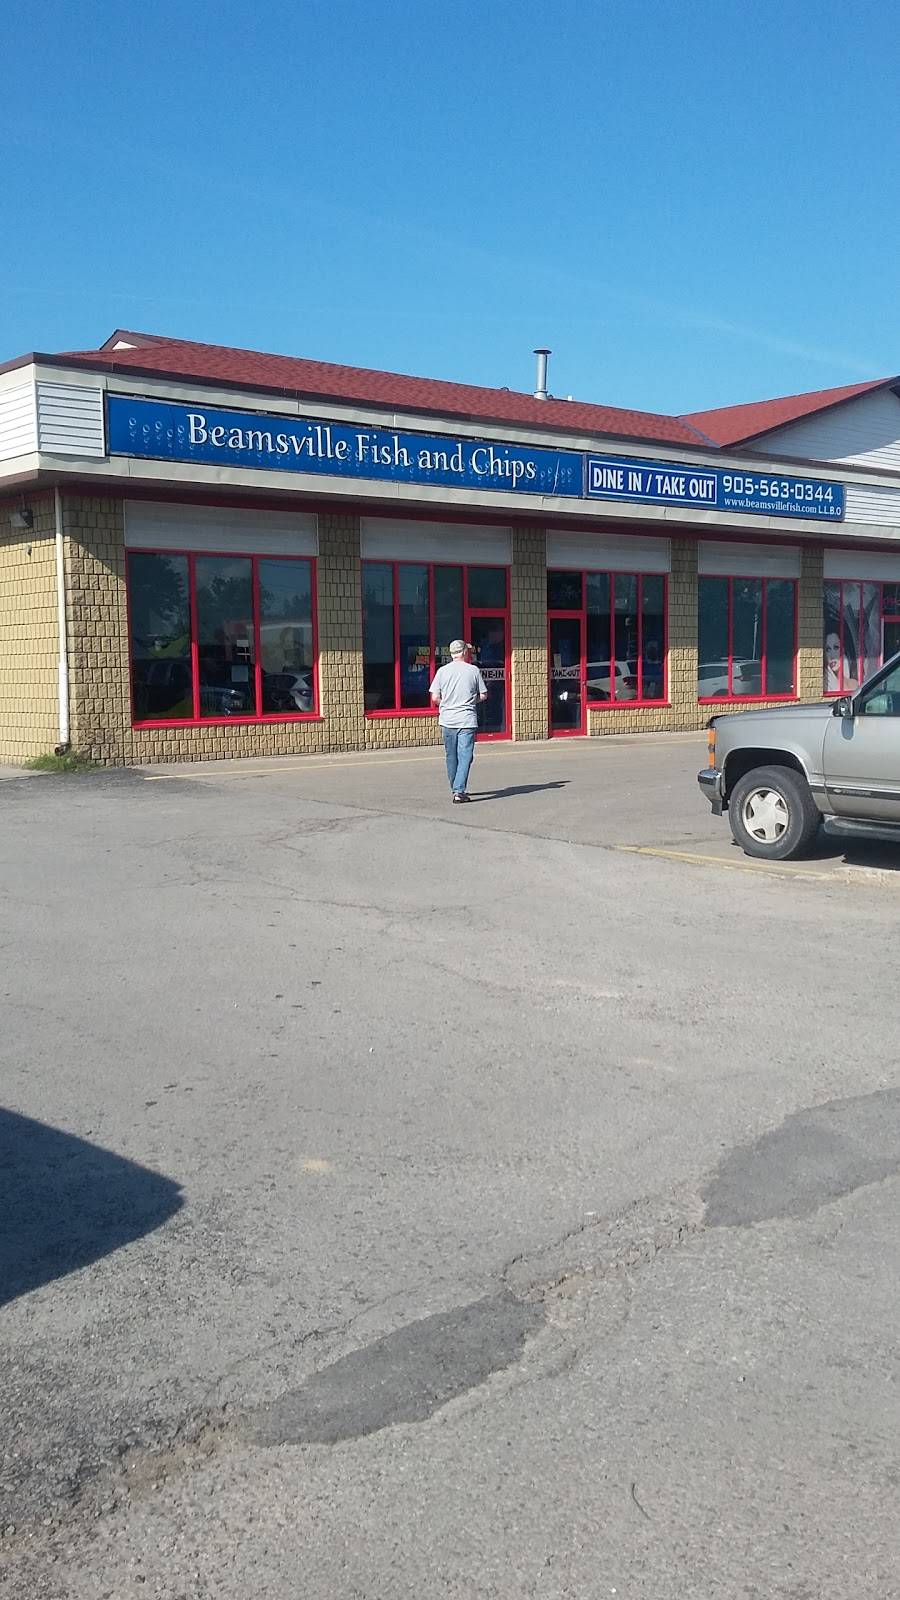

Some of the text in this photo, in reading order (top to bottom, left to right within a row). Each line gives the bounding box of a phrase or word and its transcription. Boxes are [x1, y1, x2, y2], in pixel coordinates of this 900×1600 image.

[187, 414, 537, 488] Beamsville Fish and Chips
[593, 467, 624, 490] DINE
[628, 471, 642, 492] IN
[656, 475, 686, 496] TAKE
[689, 479, 714, 499] OUT
[723, 475, 833, 502] 905-563-0344
[724, 498, 817, 514] www.beamsvillefish.com
